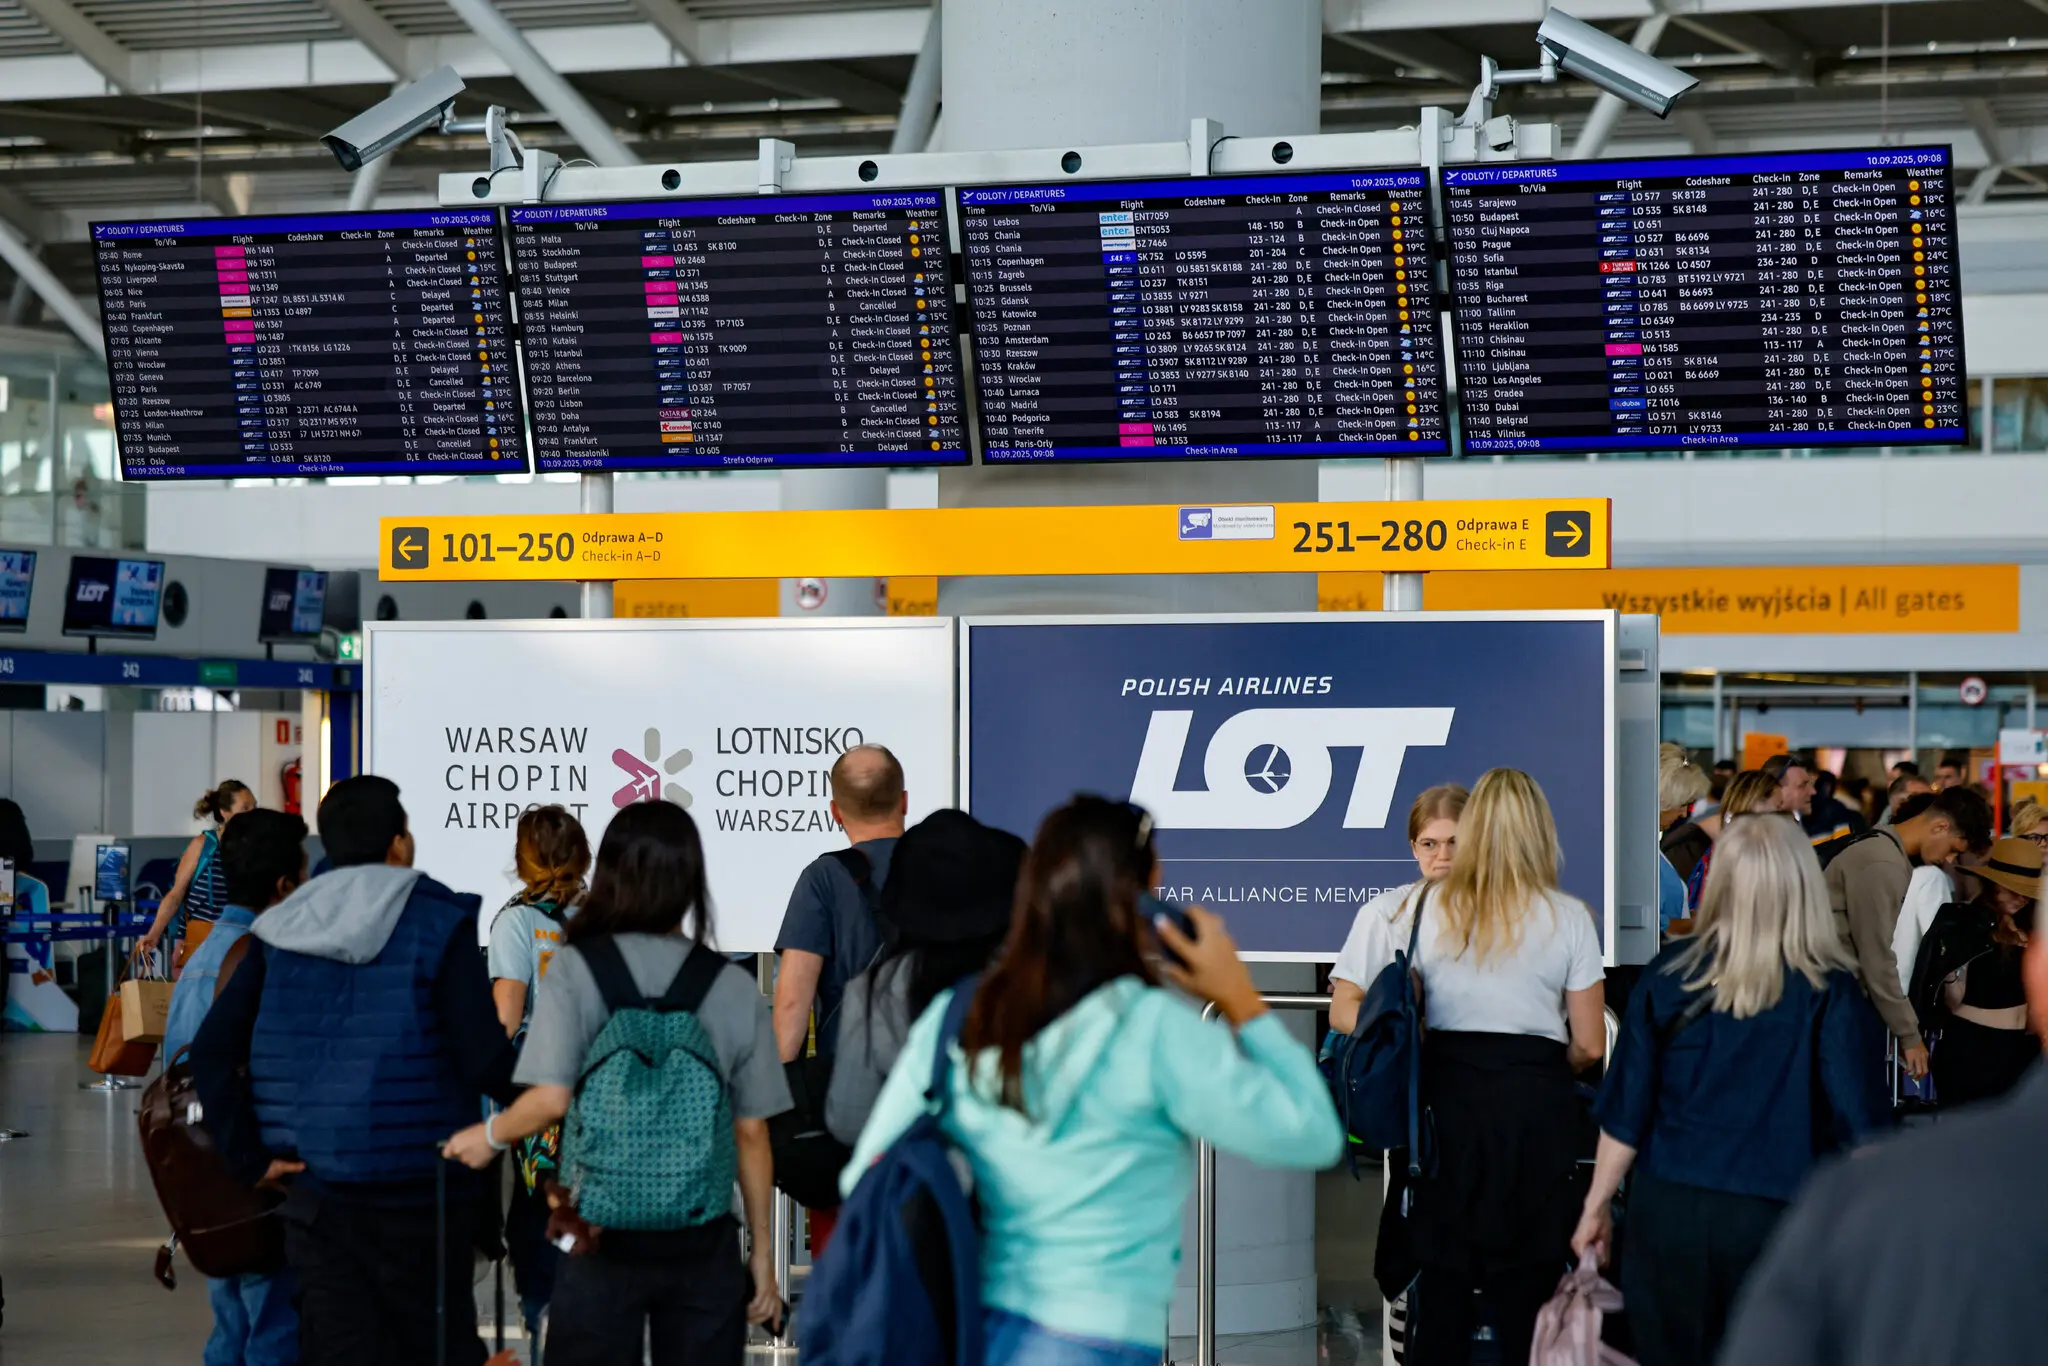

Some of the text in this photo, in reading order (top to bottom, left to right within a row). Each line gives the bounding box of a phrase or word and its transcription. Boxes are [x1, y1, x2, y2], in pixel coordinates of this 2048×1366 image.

[1867, 154, 1942, 165] 10.09.2025, 09:08
[1461, 169, 1557, 181] ODLOTY DEPARTURES
[1352, 177, 1420, 187] 10.09.2025, 09:08
[1450, 167, 1944, 195] Time To/Via Flight Codeshare Check-In Zone Remarks Weather
[976, 189, 1065, 200] ODLOTY DEPARTURES
[872, 197, 936, 206] 10.09.2025, 09:08
[966, 190, 1422, 214] Time To/Via Flight Codeshare Check-In Zone Remarks Weather
[1479, 198, 1516, 208] Sarajewo
[525, 208, 607, 218] ODLOTY DEPARTURES
[1480, 212, 1519, 222] Budapest
[575, 222, 598, 230] To/Via
[659, 219, 680, 228] Flight
[718, 216, 756, 224] Codeshare
[775, 214, 808, 222] Check-In
[814, 213, 832, 221] Zone
[853, 211, 886, 220] Remarks
[906, 209, 938, 218] Weather
[994, 217, 1019, 226] Lesbos
[994, 230, 1020, 240] Chania
[1481, 226, 1530, 236] Cluj Napoca
[996, 244, 1022, 252] Chania
[1482, 240, 1511, 250] Prague
[542, 248, 580, 256] Stockholm
[997, 257, 1044, 267] Copenhagen
[1483, 254, 1504, 262] Sofia
[544, 261, 577, 270] Budapest
[998, 270, 1025, 280] Zagreb
[1484, 266, 1518, 276] Istanbul
[545, 274, 578, 283] Stuttgart
[547, 286, 570, 294] Venice
[1000, 283, 1032, 292] Brussels
[1486, 281, 1504, 291] Riga
[548, 299, 568, 307] Milan
[1001, 296, 1029, 305] Gdansk
[1487, 294, 1528, 303] Bucharest
[550, 311, 578, 320] Helsinki
[1002, 310, 1036, 318] Katowice
[1488, 308, 1516, 316] Tallinn
[551, 324, 584, 333] Hamburg
[1489, 321, 1529, 330] Heraklion
[553, 336, 577, 344] Kutaisi
[1005, 336, 1049, 344] Amsterdam
[1490, 335, 1524, 344] Chisinau
[554, 349, 583, 357] Istanbul
[1491, 348, 1526, 357] Chisinau
[556, 362, 580, 370] Athens
[1492, 362, 1530, 372] Ljubljana
[557, 374, 592, 382] Barcelona
[1008, 375, 1041, 383] Wroclaw
[1493, 375, 1542, 385] Los Angeles
[558, 387, 580, 395] Berlin
[1010, 388, 1040, 396] Larnaca
[1494, 389, 1524, 398] Oradea
[1011, 401, 1038, 409] Madrid
[1496, 402, 1519, 411] Dubai
[561, 412, 579, 420] Doha
[1012, 414, 1050, 424] Podgorica
[1496, 416, 1528, 426] Belgrad
[563, 424, 590, 434] Antalya
[1013, 426, 1044, 435] Tenerife
[1497, 429, 1526, 438] Vilnius
[564, 437, 598, 445] Frankfurt
[1015, 440, 1053, 448] Paris-Orly
[723, 456, 773, 464] Strefa Odpraw
[1456, 519, 1529, 531] Odprawa E
[582, 532, 635, 546] Odprawa
[1293, 520, 1447, 552] 251–280
[443, 532, 575, 562] 101–250
[1456, 538, 1527, 551] Check-in E
[582, 549, 633, 562] Check-in
[1602, 586, 1965, 619] Wszystkie wyjścia All gates
[122, 661, 140, 678] 242
[1121, 676, 1333, 697] POLISH AIRLINES
[445, 727, 588, 753] WARSAW
[716, 727, 864, 755] LOTNISKO
[1127, 707, 1456, 830] LOT
[445, 764, 588, 791] CHOPIN
[444, 803, 589, 829] AIRPT
[716, 809, 845, 832] WARSZAW
[1154, 886, 1395, 903] TAR ALLIANCE MEMB
